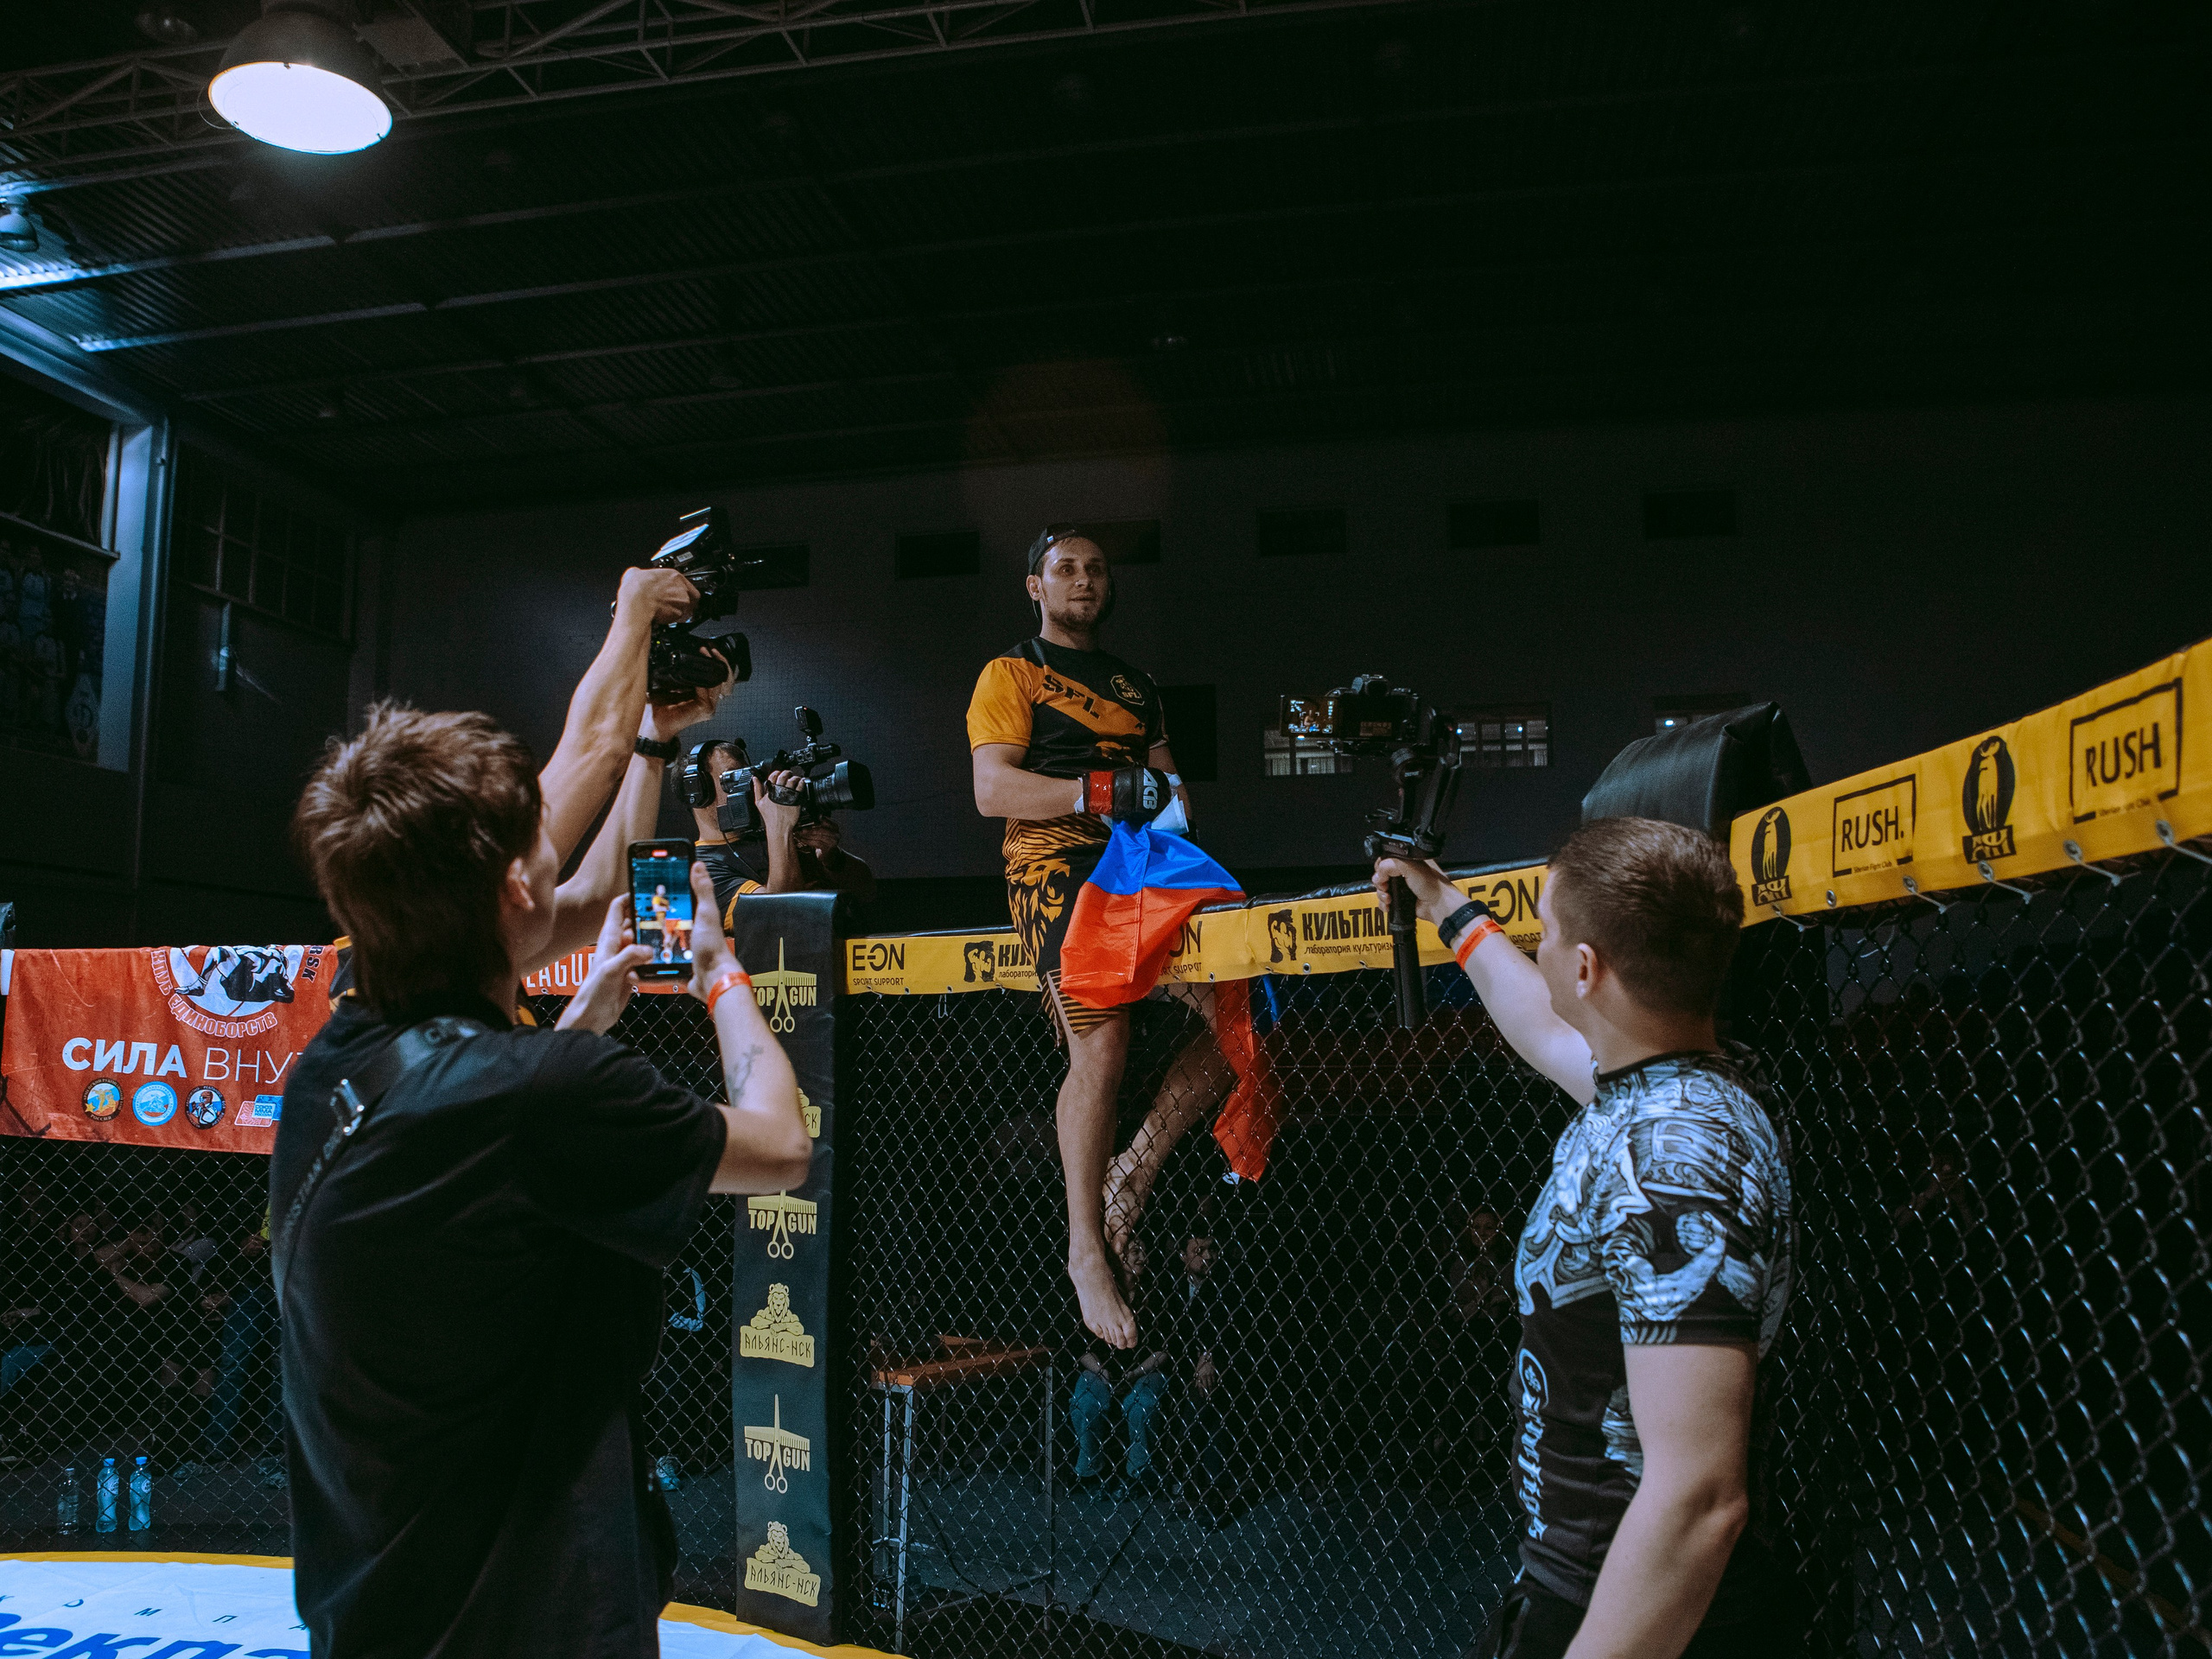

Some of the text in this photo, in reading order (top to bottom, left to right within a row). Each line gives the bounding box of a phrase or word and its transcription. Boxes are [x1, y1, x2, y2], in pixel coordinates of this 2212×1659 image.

[1042, 674, 1101, 721] SFL
[2085, 721, 2161, 788] RUSH
[789, 986, 817, 1007] GUN
[874, 977, 905, 986] SUPPORT
[168, 993, 278, 1039] ЕДИНОБОРСТВ
[62, 1037, 303, 1084] СИЛА ВНУ
[748, 1209, 817, 1235] TOP GUN
[745, 1438, 810, 1471] TOP GUN
